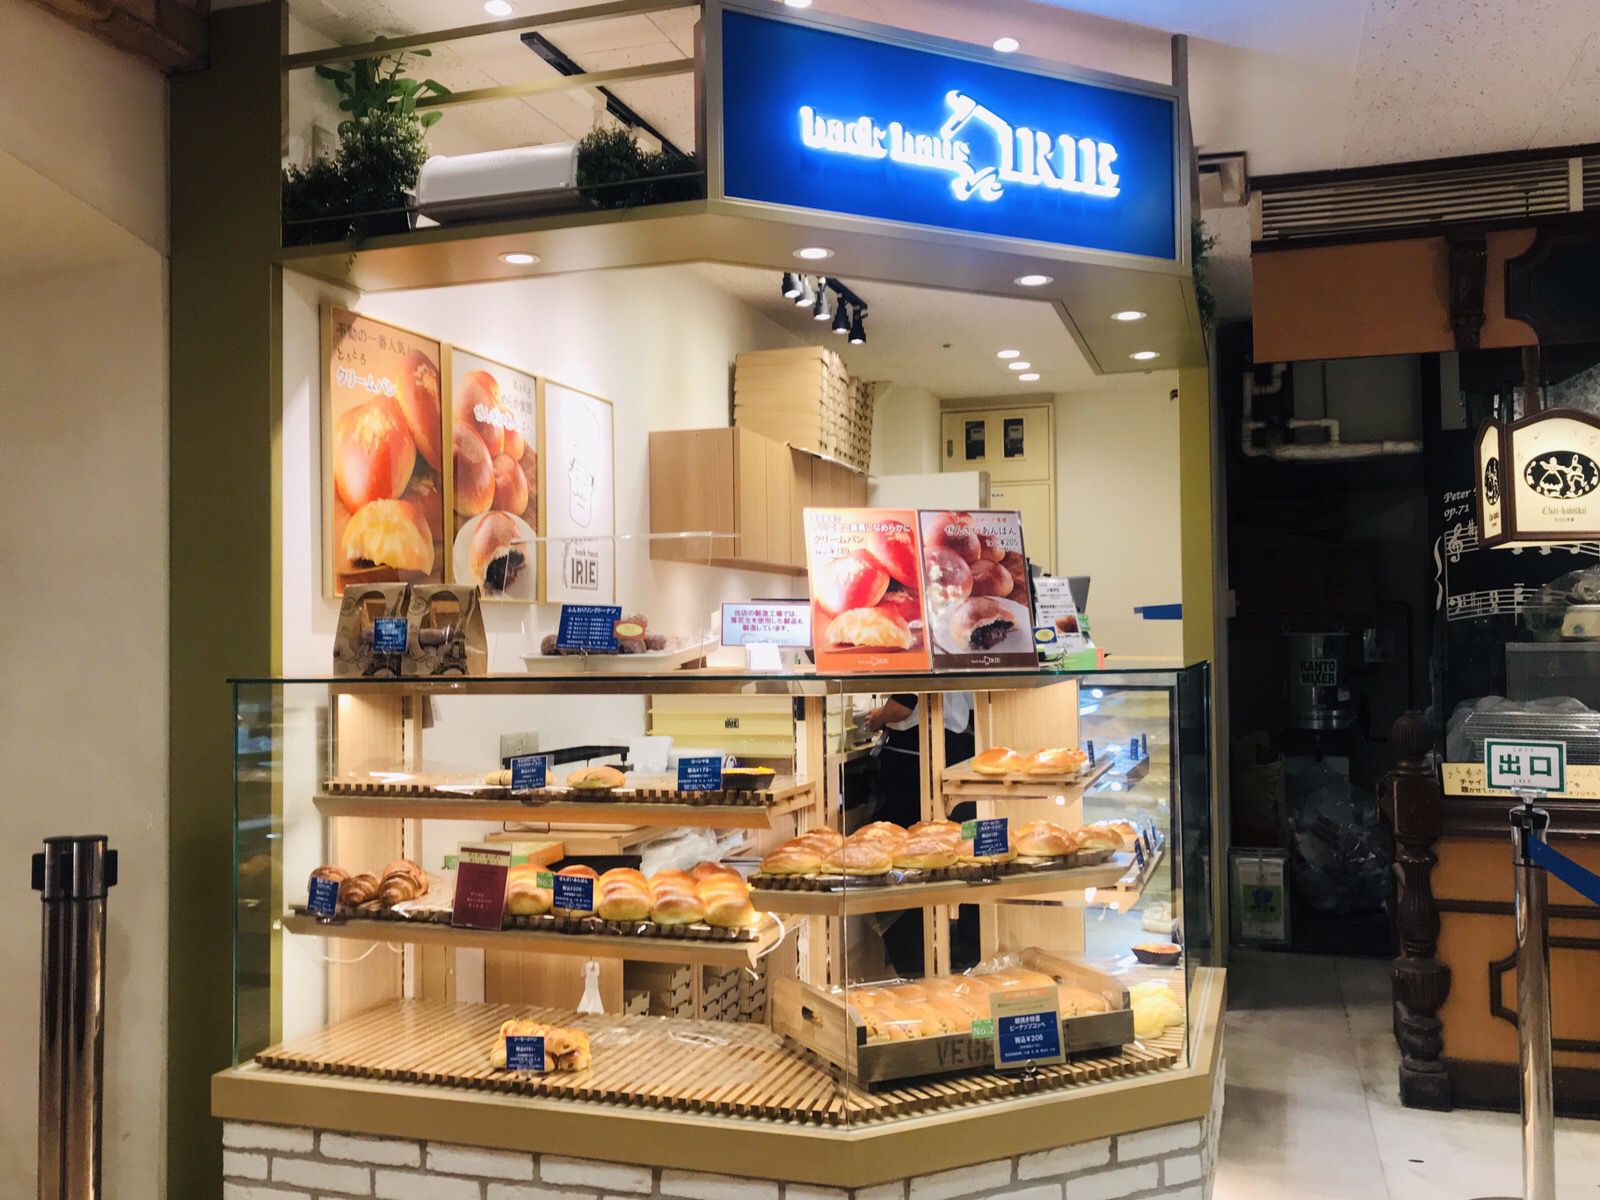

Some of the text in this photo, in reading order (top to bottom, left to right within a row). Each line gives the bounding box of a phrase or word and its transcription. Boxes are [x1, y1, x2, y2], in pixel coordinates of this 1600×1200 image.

[1443, 489, 1472, 503] Peter
[1443, 504, 1470, 522] op.71
[571, 557, 596, 585] IRIE
[1300, 660, 1336, 672] KANTO
[1301, 672, 1335, 686] MIXER
[1499, 754, 1552, 776] 出口
[973, 1025, 994, 1035] No.2
